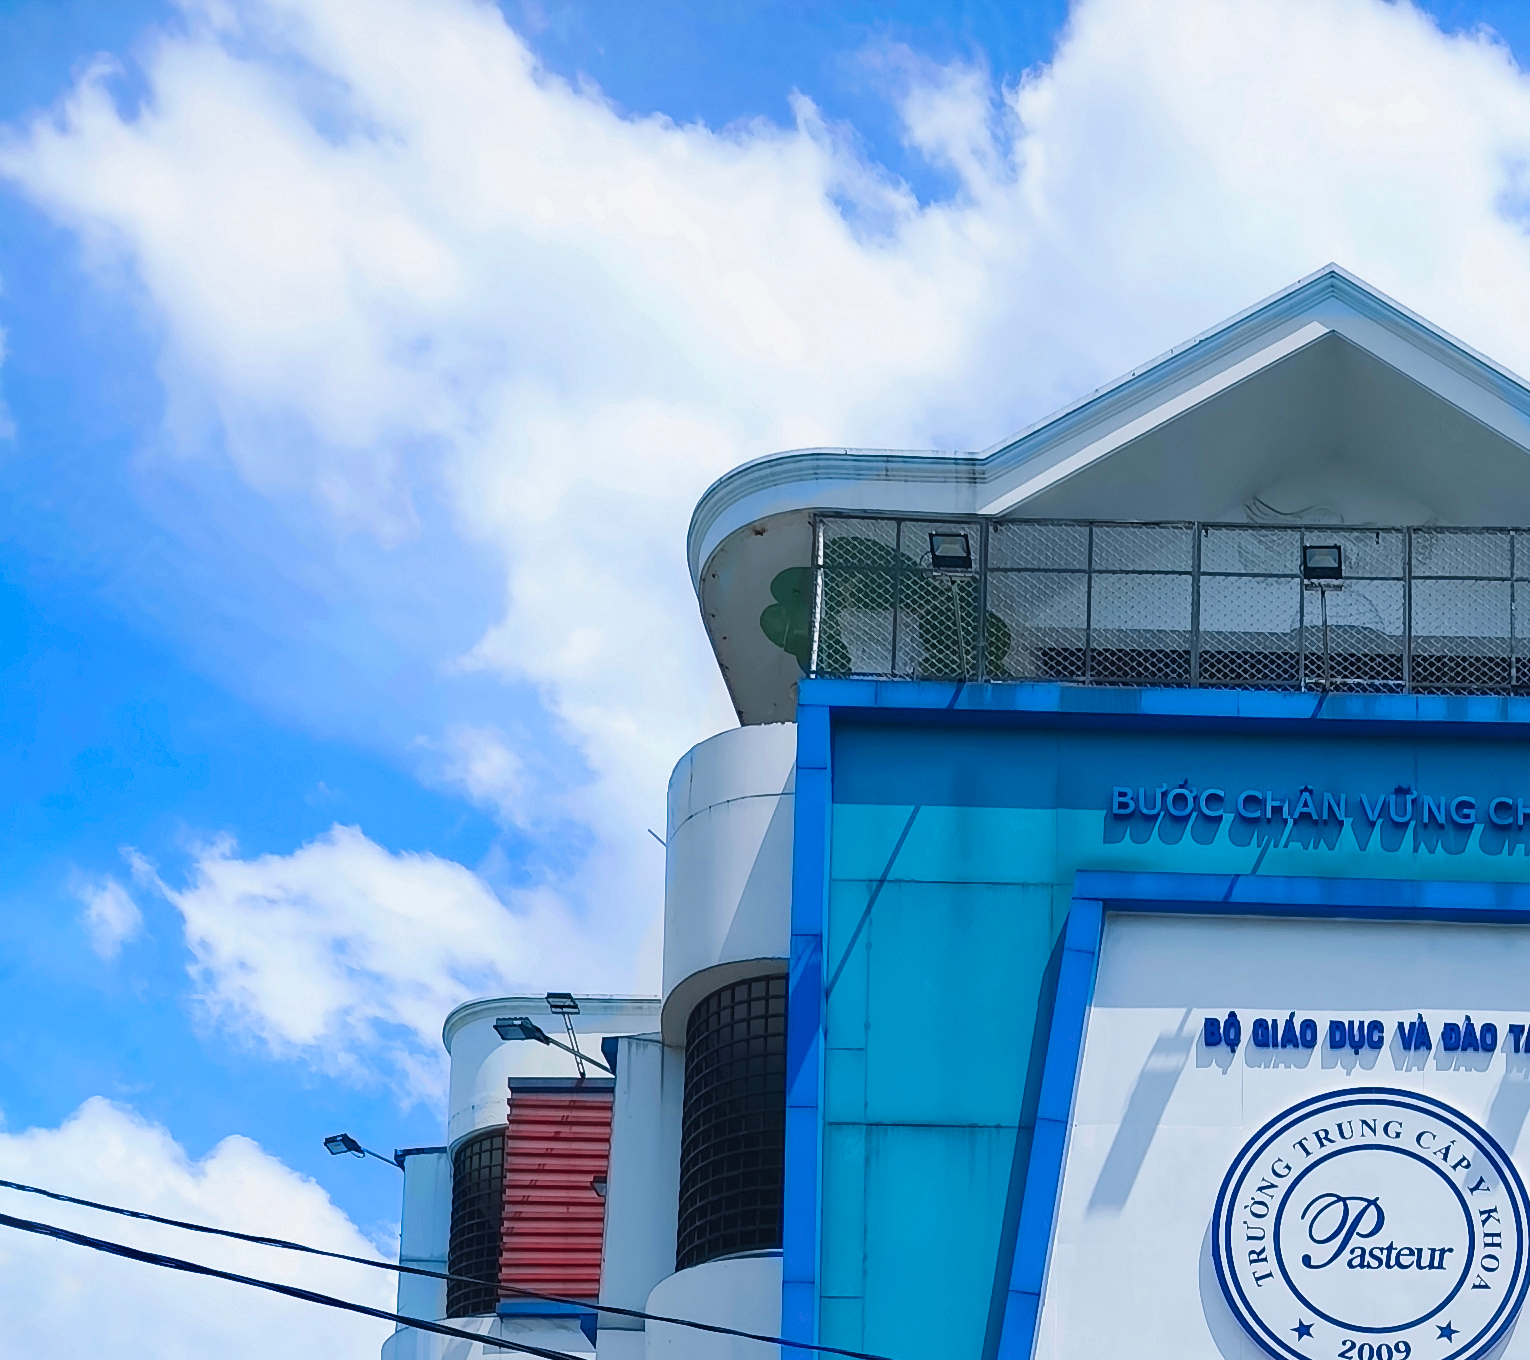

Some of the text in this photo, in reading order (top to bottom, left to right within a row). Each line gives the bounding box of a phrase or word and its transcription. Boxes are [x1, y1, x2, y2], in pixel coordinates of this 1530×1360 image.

[1111, 778, 1225, 818] BƯỚC
[1237, 784, 1347, 822] CHÂN
[1203, 1011, 1242, 1054] BỘ
[1252, 1012, 1318, 1049] GIÁO
[1329, 1019, 1385, 1055] DỤC
[1397, 1012, 1432, 1052] VÀ
[1441, 1014, 1498, 1053] ĐÀO
[1292, 1118, 1404, 1160] TRUNG
[1467, 1175, 1491, 1197] Y
[1243, 1157, 1293, 1288] TRƯỜNG
[1300, 1192, 1454, 1270] Pasteur
[1471, 1204, 1503, 1291] KHOA
